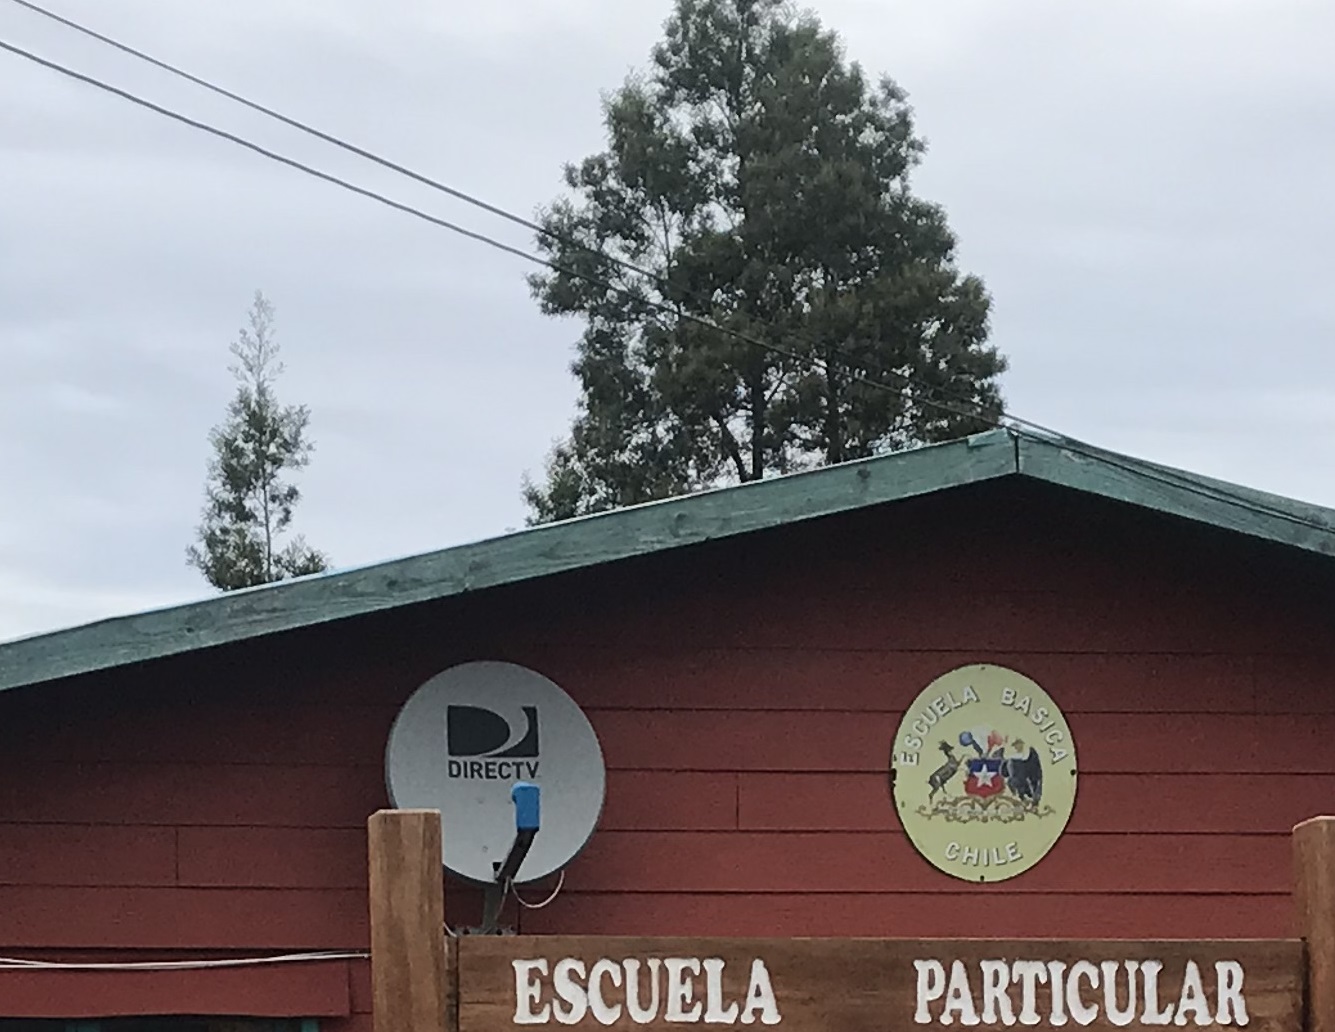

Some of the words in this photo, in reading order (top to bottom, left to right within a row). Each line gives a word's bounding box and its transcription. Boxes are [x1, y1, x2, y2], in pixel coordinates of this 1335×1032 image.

[899, 685, 980, 767] ESCUELA
[1001, 686, 1068, 765] BASICA
[448, 760, 540, 780] DIRECTV
[945, 841, 1023, 868] CHILE
[511, 958, 782, 1025] ESCUELA
[913, 958, 1250, 1026] PARTICULAR
